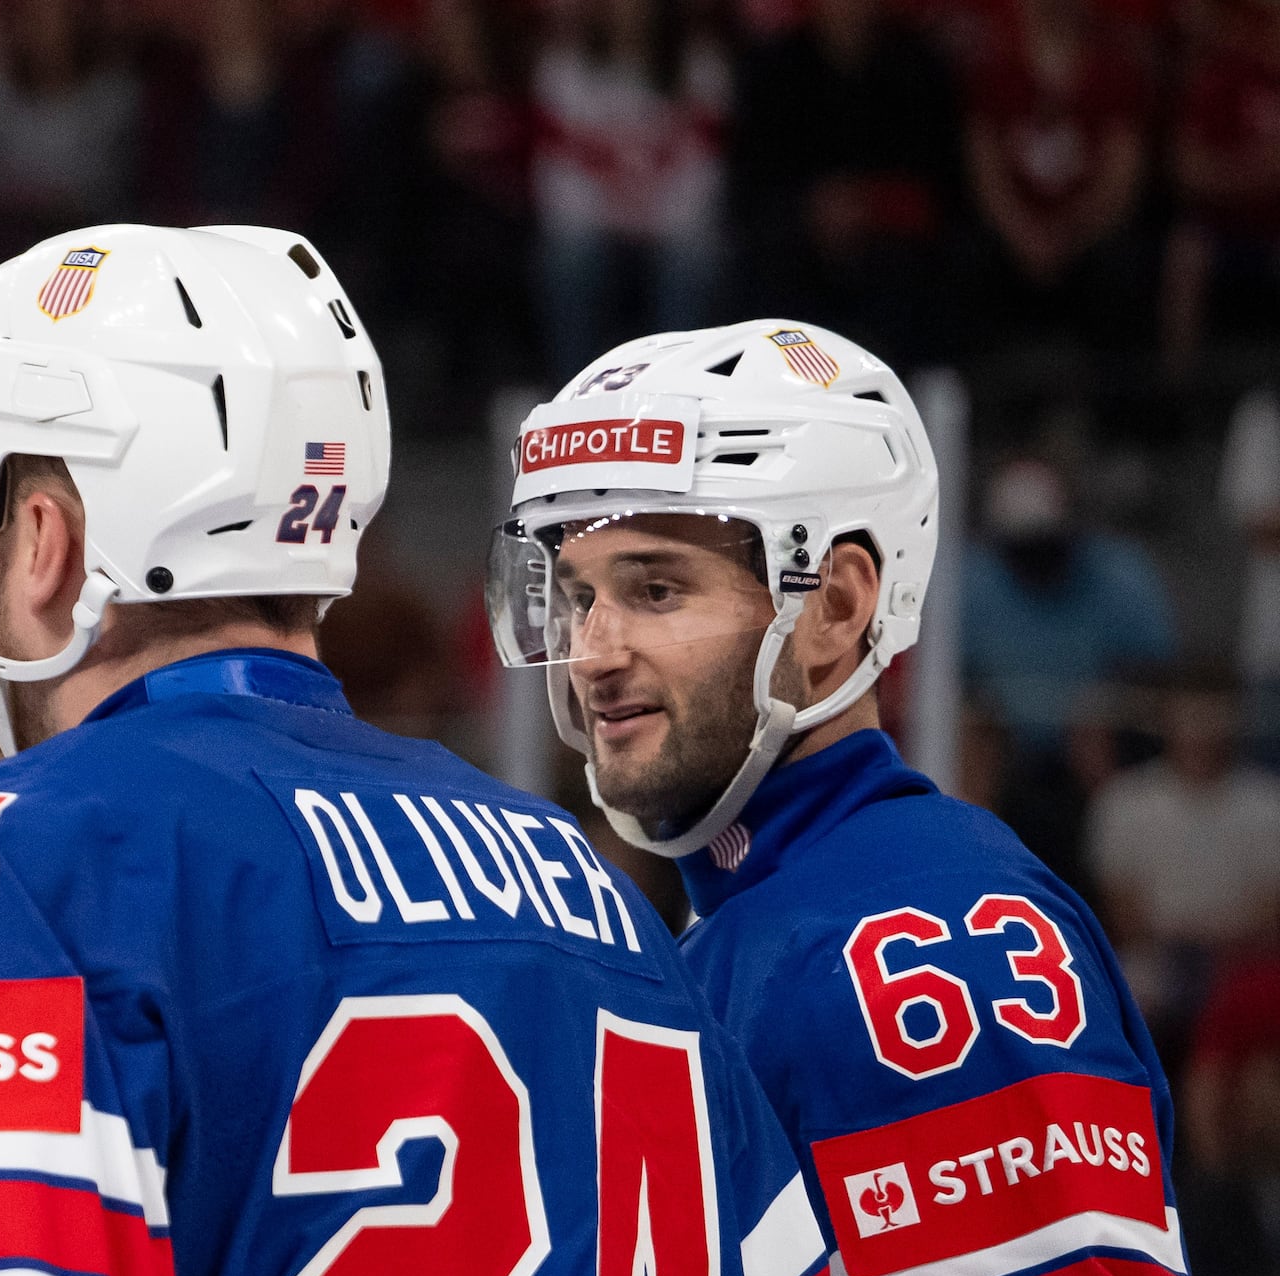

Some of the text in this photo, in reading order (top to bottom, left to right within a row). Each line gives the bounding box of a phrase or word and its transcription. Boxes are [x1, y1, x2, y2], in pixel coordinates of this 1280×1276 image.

[69, 252, 95, 265] USA
[776, 332, 803, 345] USA
[525, 427, 673, 465] CHIPOTLE
[274, 483, 347, 545] 24
[294, 788, 642, 953] OLIVIER
[842, 893, 1088, 1081] 63
[927, 1121, 1151, 1206] STRAUSS
